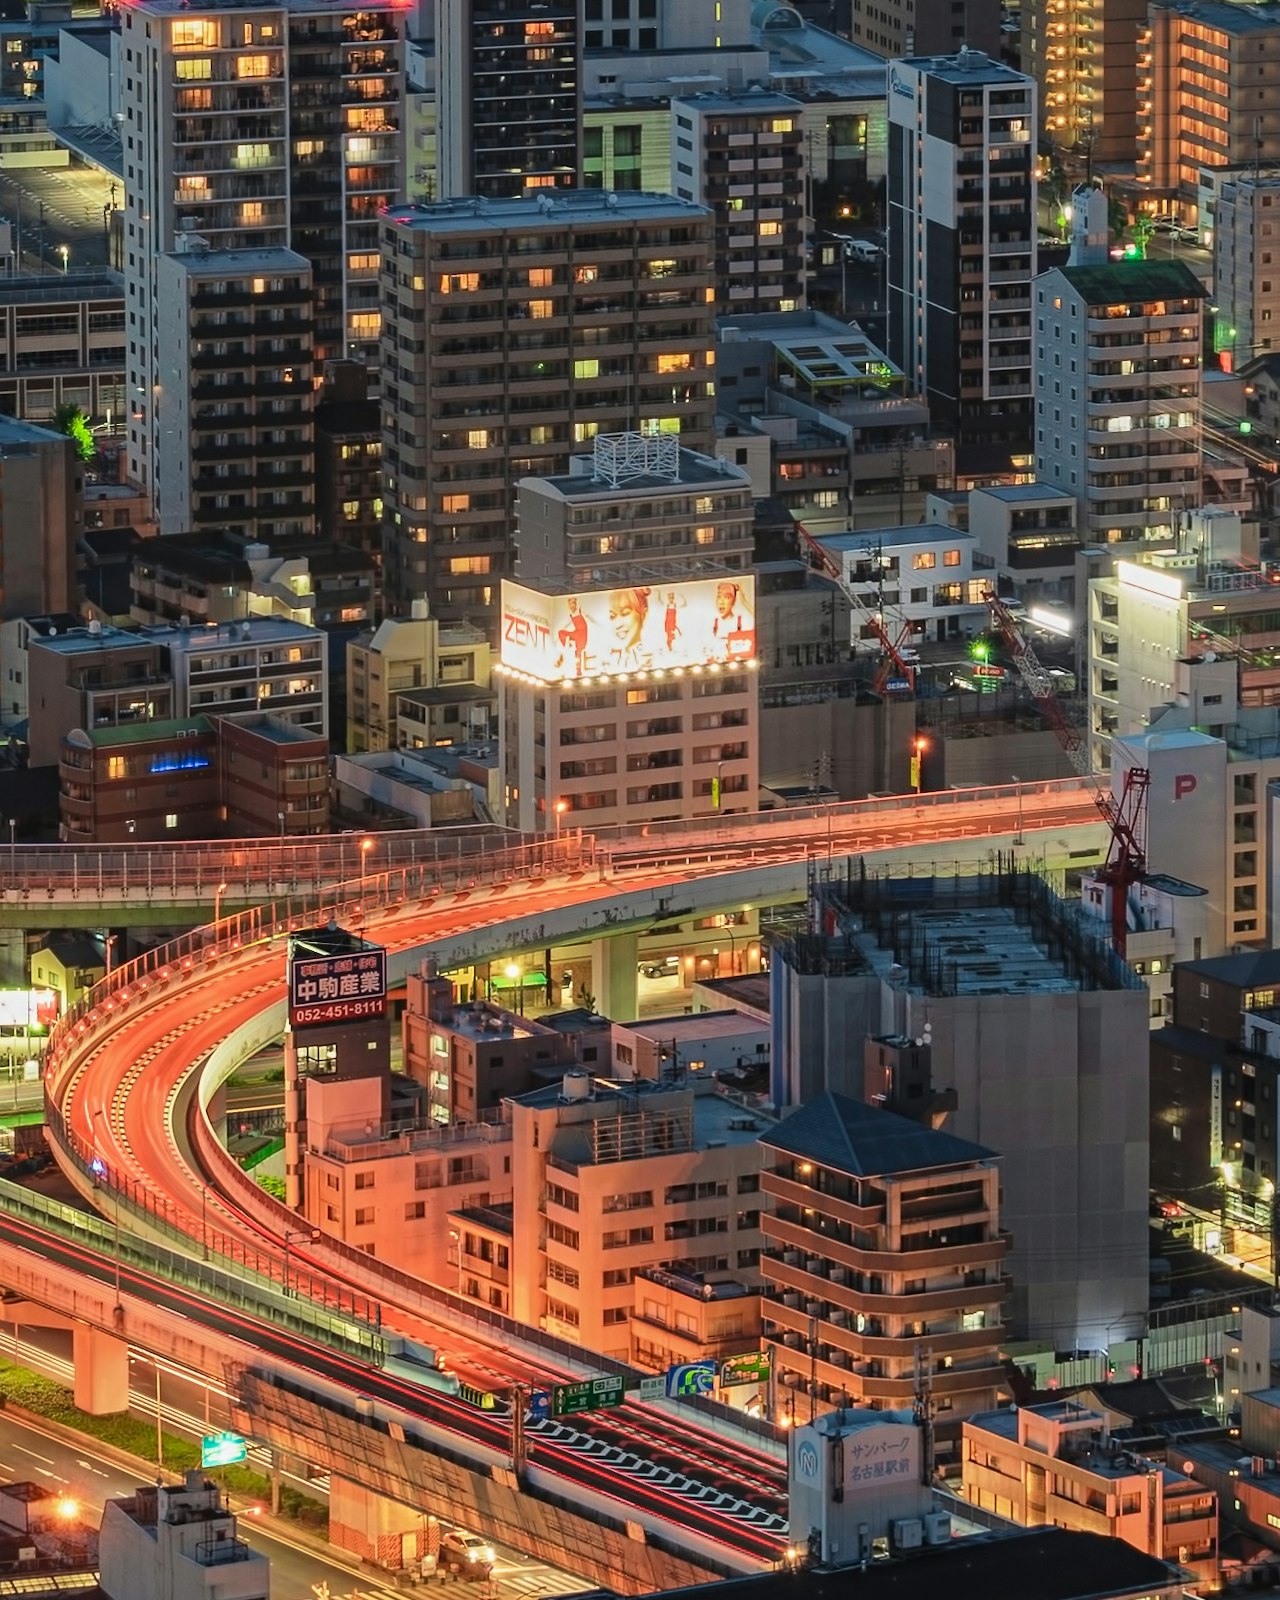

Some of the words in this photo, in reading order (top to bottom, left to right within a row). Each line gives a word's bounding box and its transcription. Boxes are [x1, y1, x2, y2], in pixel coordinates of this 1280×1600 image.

[504, 613, 551, 653] ZENT
[1175, 774, 1197, 800] P
[297, 970, 382, 1002] 中駒産業
[296, 1000, 384, 1023] 052-451-8111
[851, 1458, 911, 1482] 名古屋駅前
